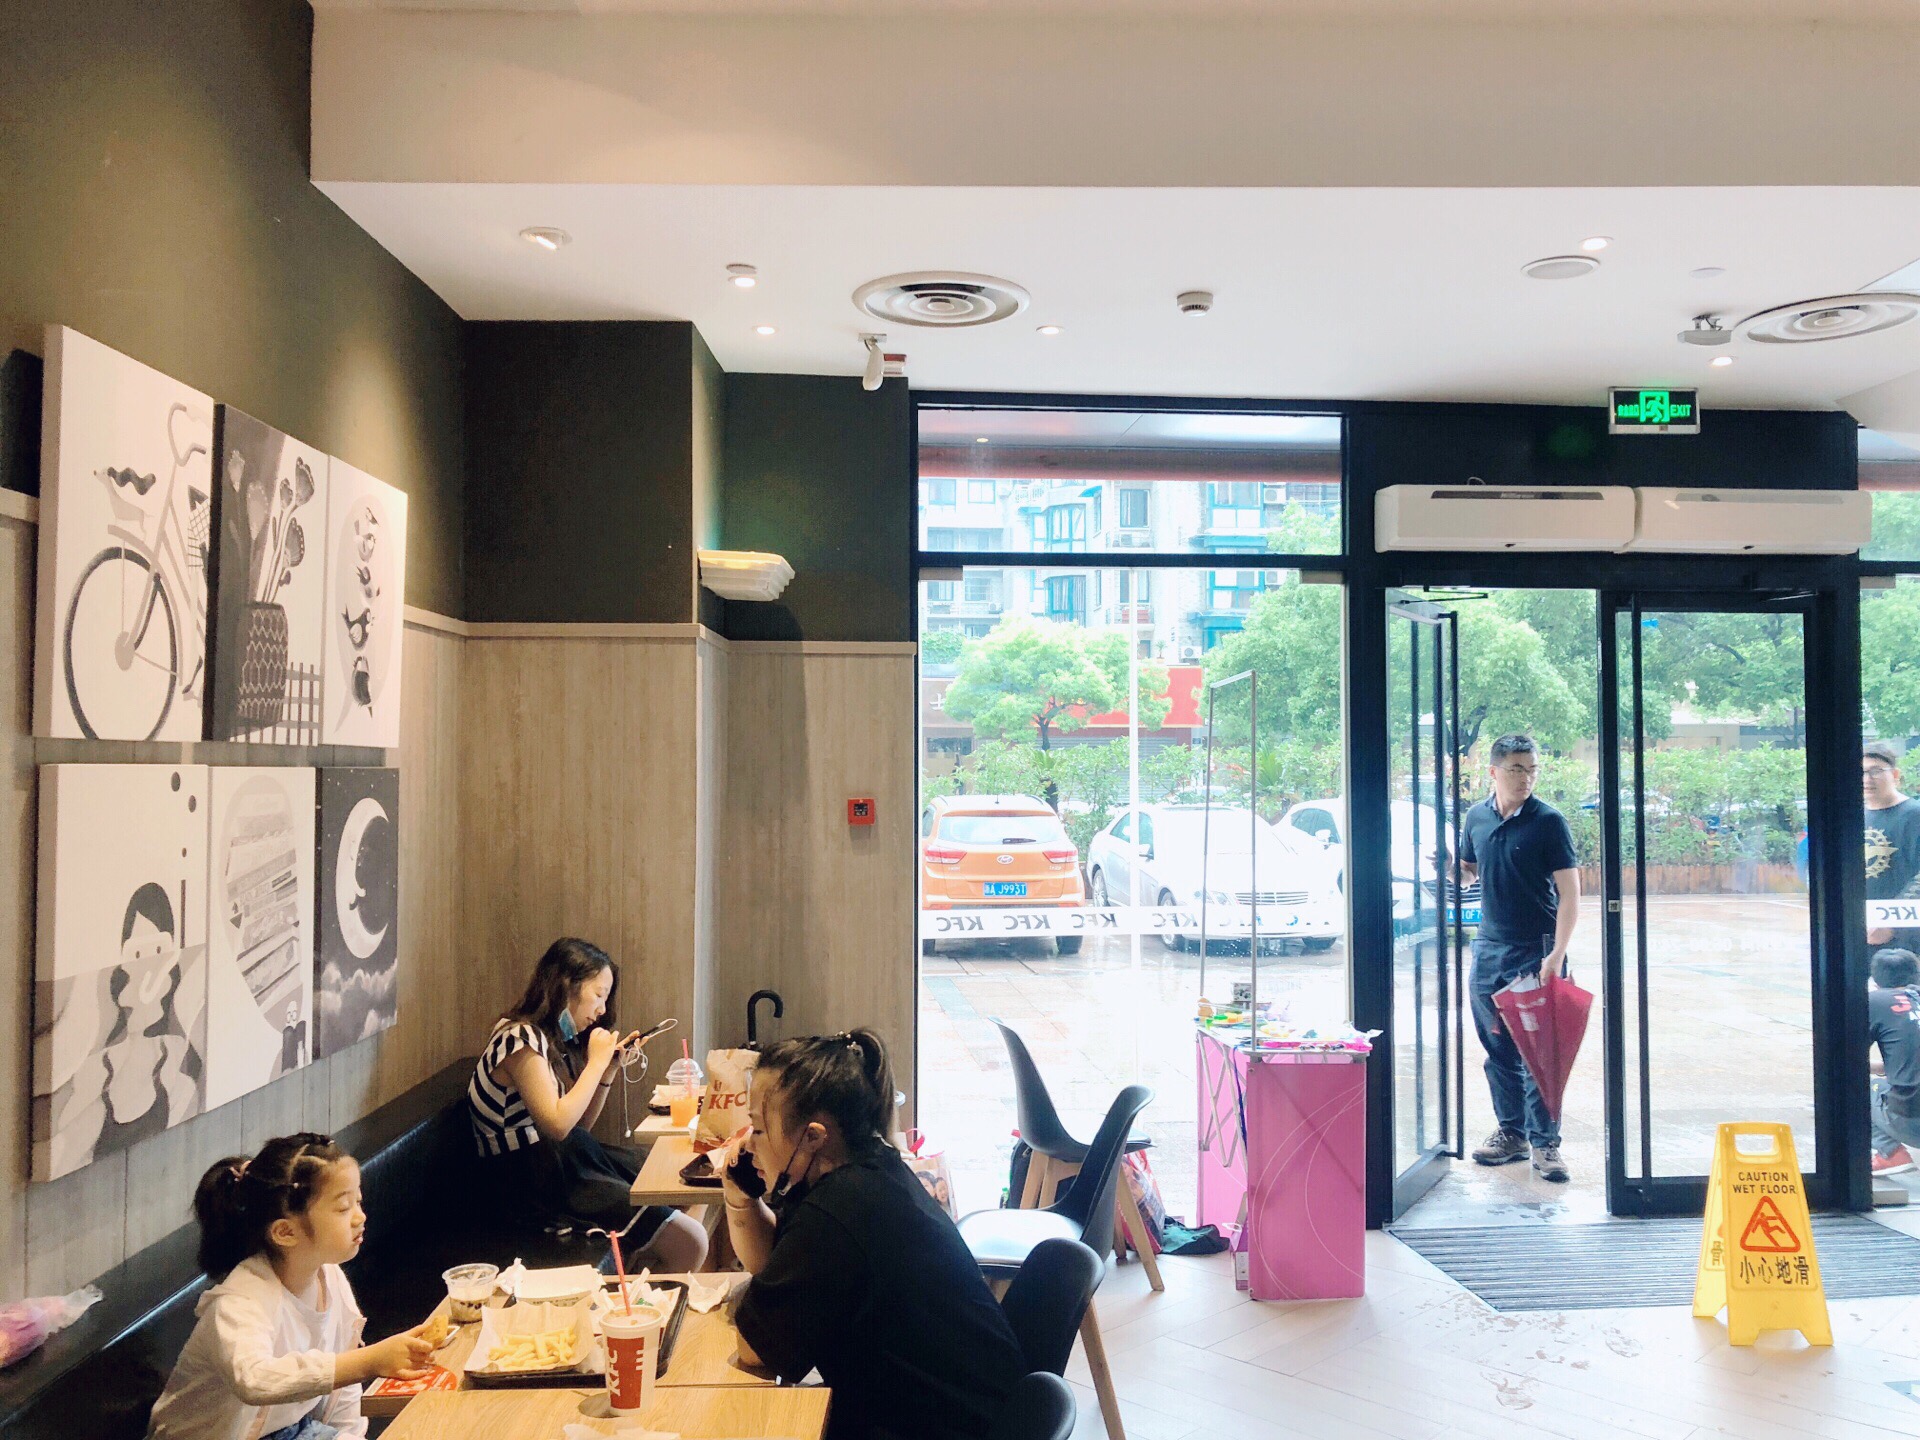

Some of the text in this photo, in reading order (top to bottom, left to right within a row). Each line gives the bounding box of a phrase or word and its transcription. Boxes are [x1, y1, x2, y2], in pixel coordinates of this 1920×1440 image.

[1671, 404, 1692, 417] EXIT
[708, 1090, 748, 1110] KFC
[1738, 1171, 1789, 1182] CAUTION
[1733, 1184, 1796, 1194] WET FLOOR
[1740, 1255, 1810, 1285] 小心地滑
